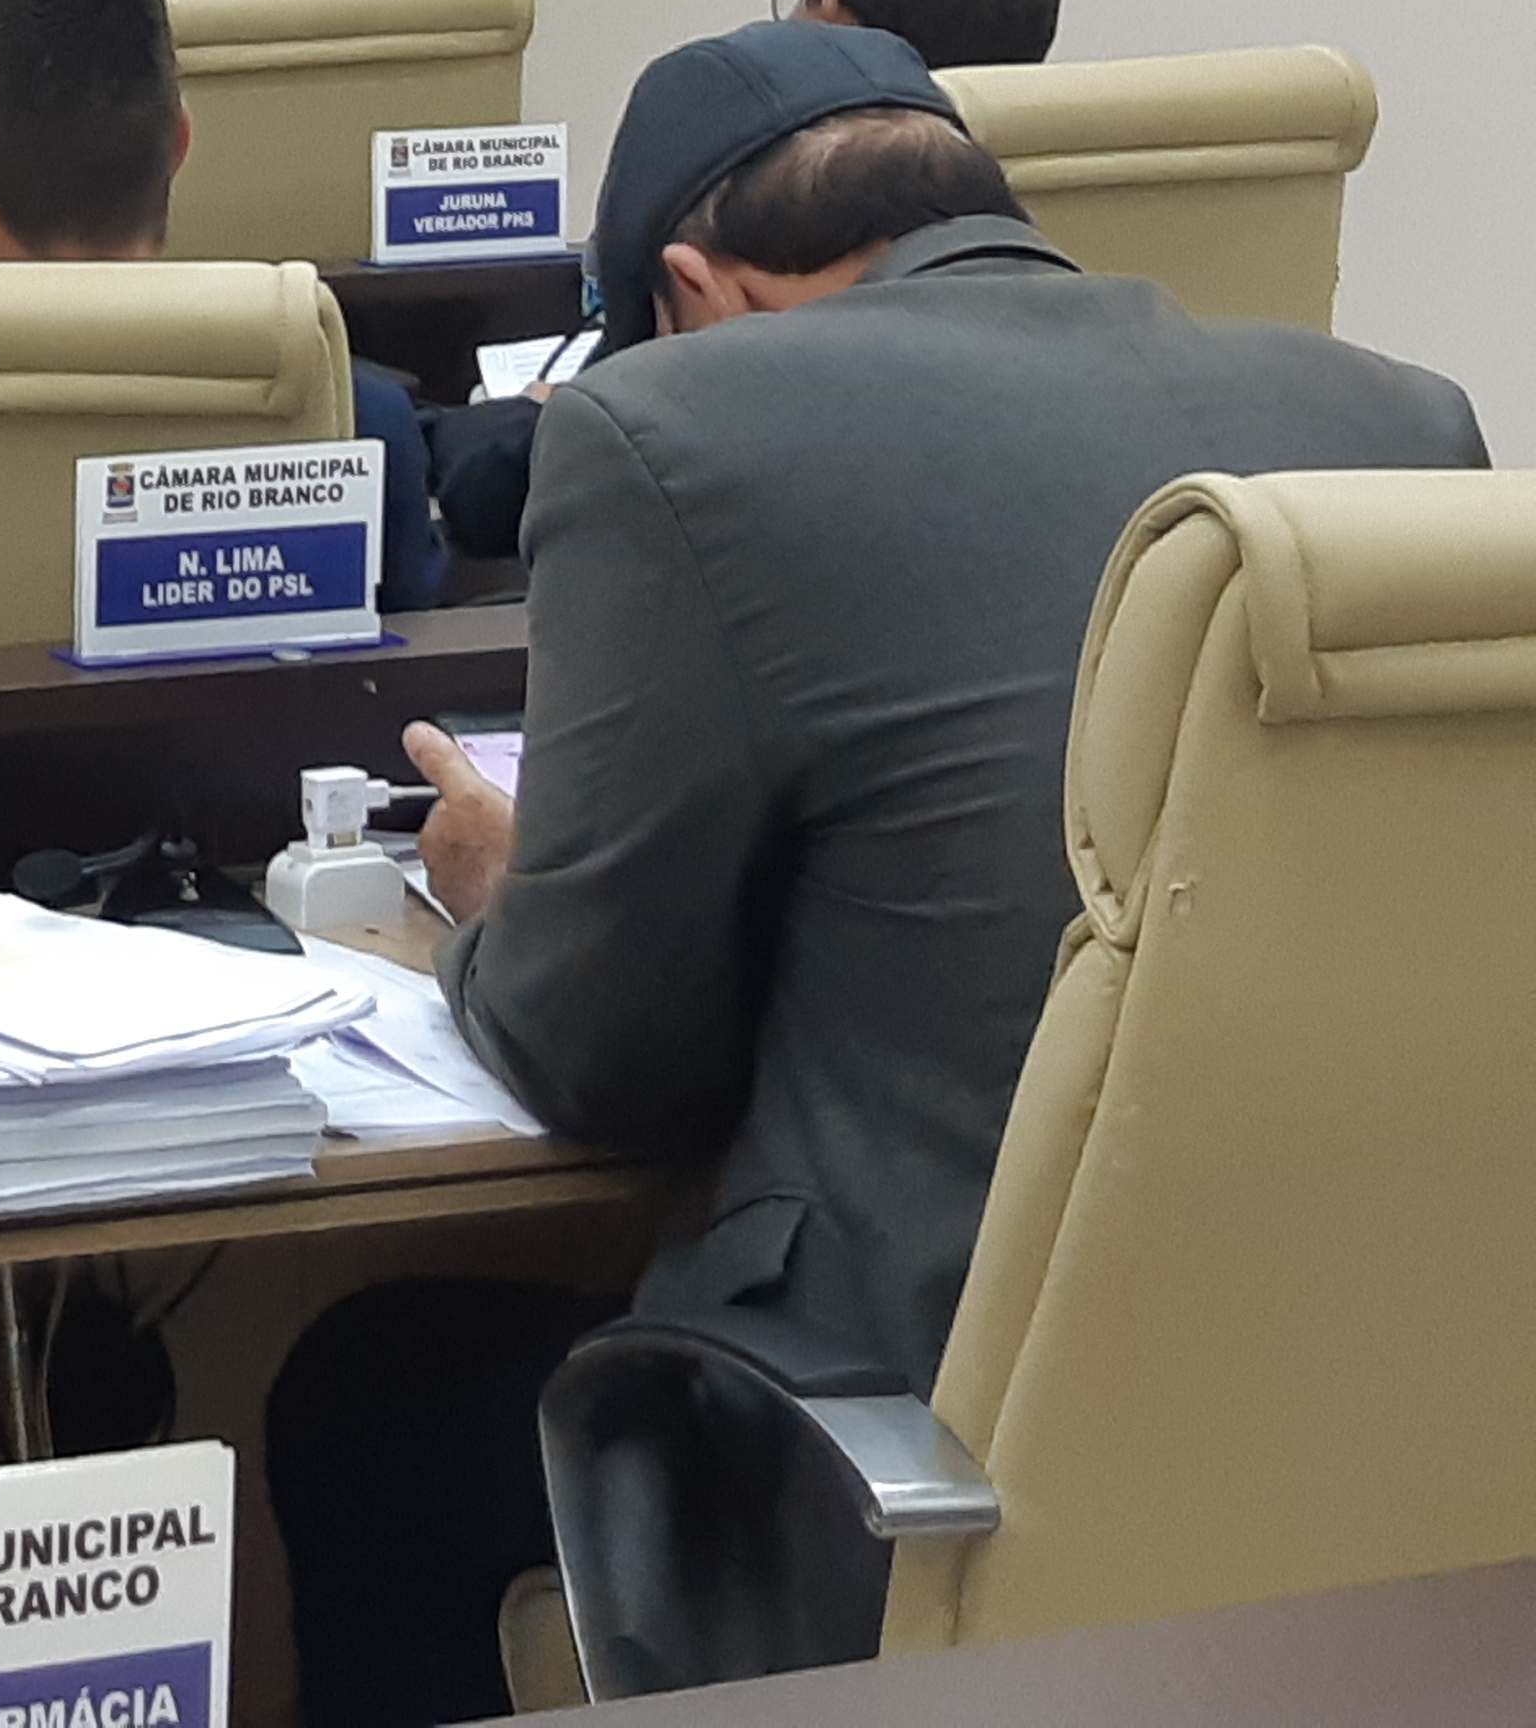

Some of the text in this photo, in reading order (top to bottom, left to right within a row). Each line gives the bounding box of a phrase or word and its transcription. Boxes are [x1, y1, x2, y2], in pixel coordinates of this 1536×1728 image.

[412, 133, 560, 156] CÂMARA MUNICIPAL
[428, 153, 544, 171] DE RIO BRANCO
[439, 192, 507, 211] JURUNA
[413, 212, 500, 235] VEREADOR
[139, 456, 369, 491] CÂMARA MUNICIPAL
[163, 482, 344, 515] DE RIO BRANCO
[179, 544, 285, 577] N. LIMA
[142, 573, 314, 607] LIDER DO PSL
